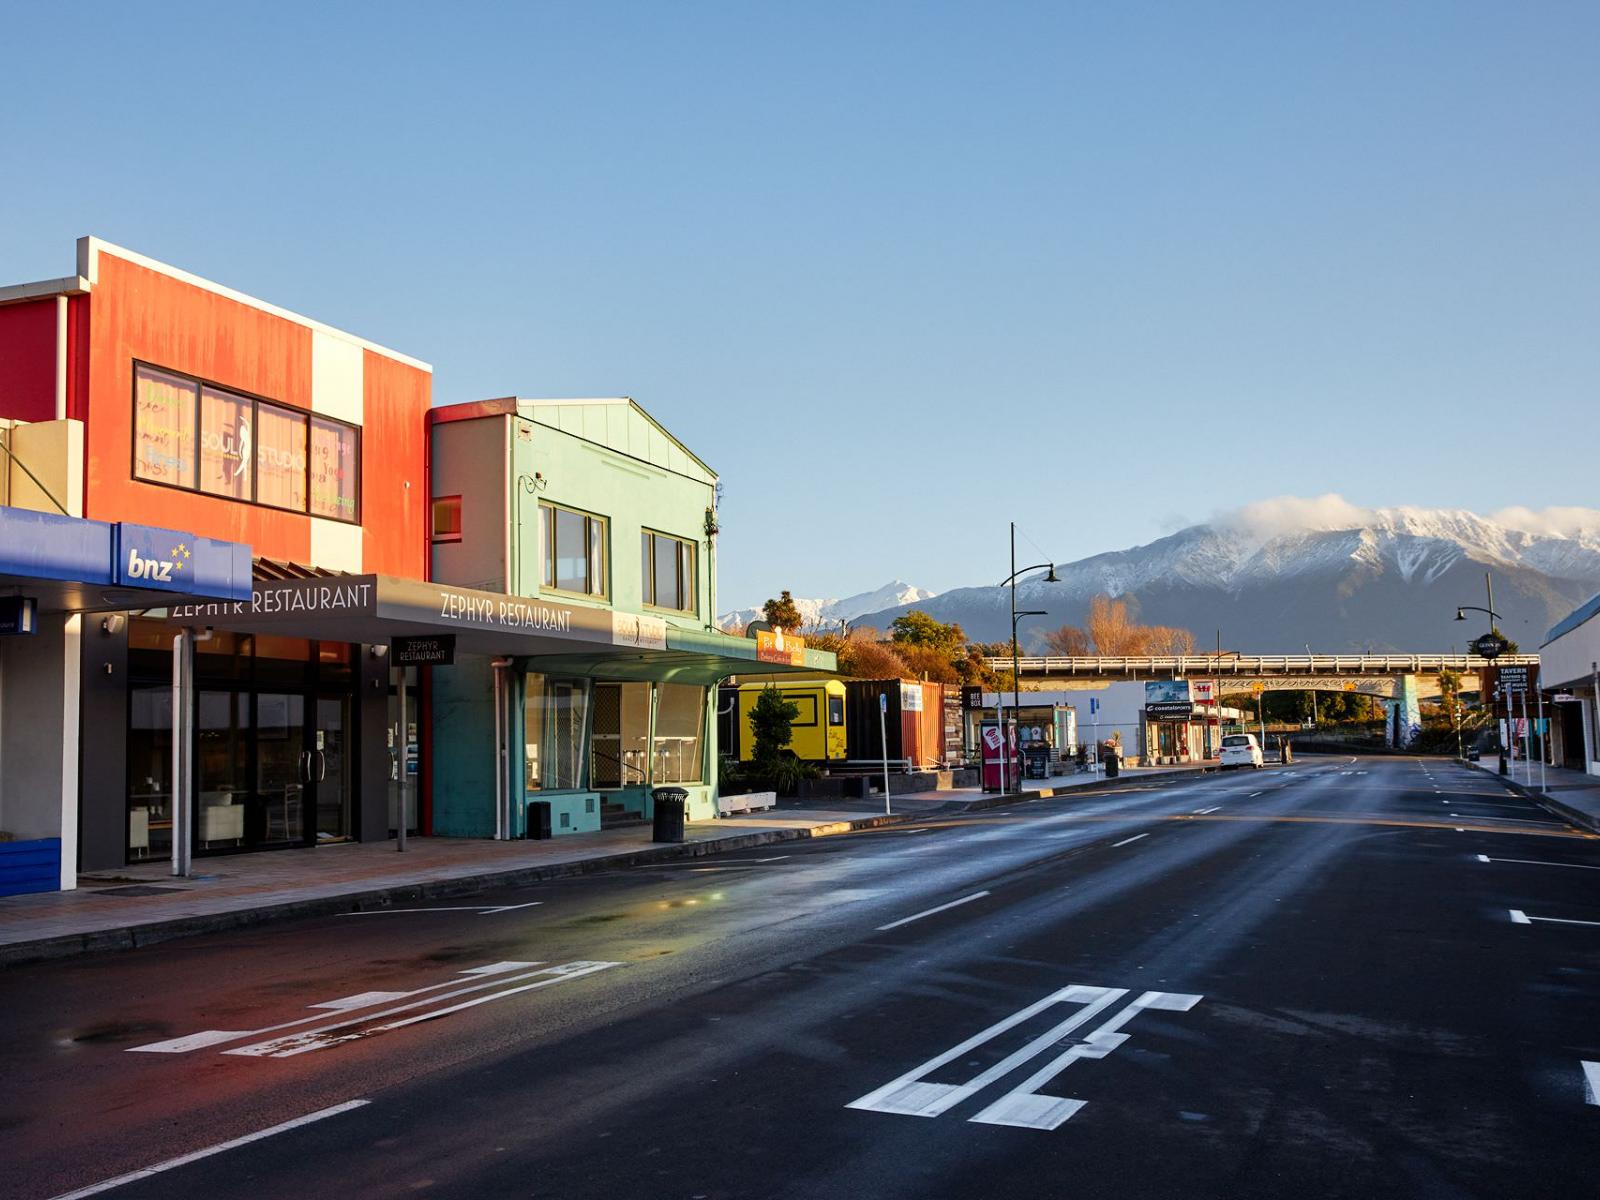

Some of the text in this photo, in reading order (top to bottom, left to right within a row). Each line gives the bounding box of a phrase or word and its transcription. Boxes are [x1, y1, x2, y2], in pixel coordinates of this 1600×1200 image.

[128, 549, 173, 582] bnz
[252, 584, 371, 613] RESTAURANT
[440, 593, 572, 632] ZEPHYR RESTAURANT
[400, 650, 445, 660] RESTAURANT
[408, 640, 439, 651] ZEPHYR
